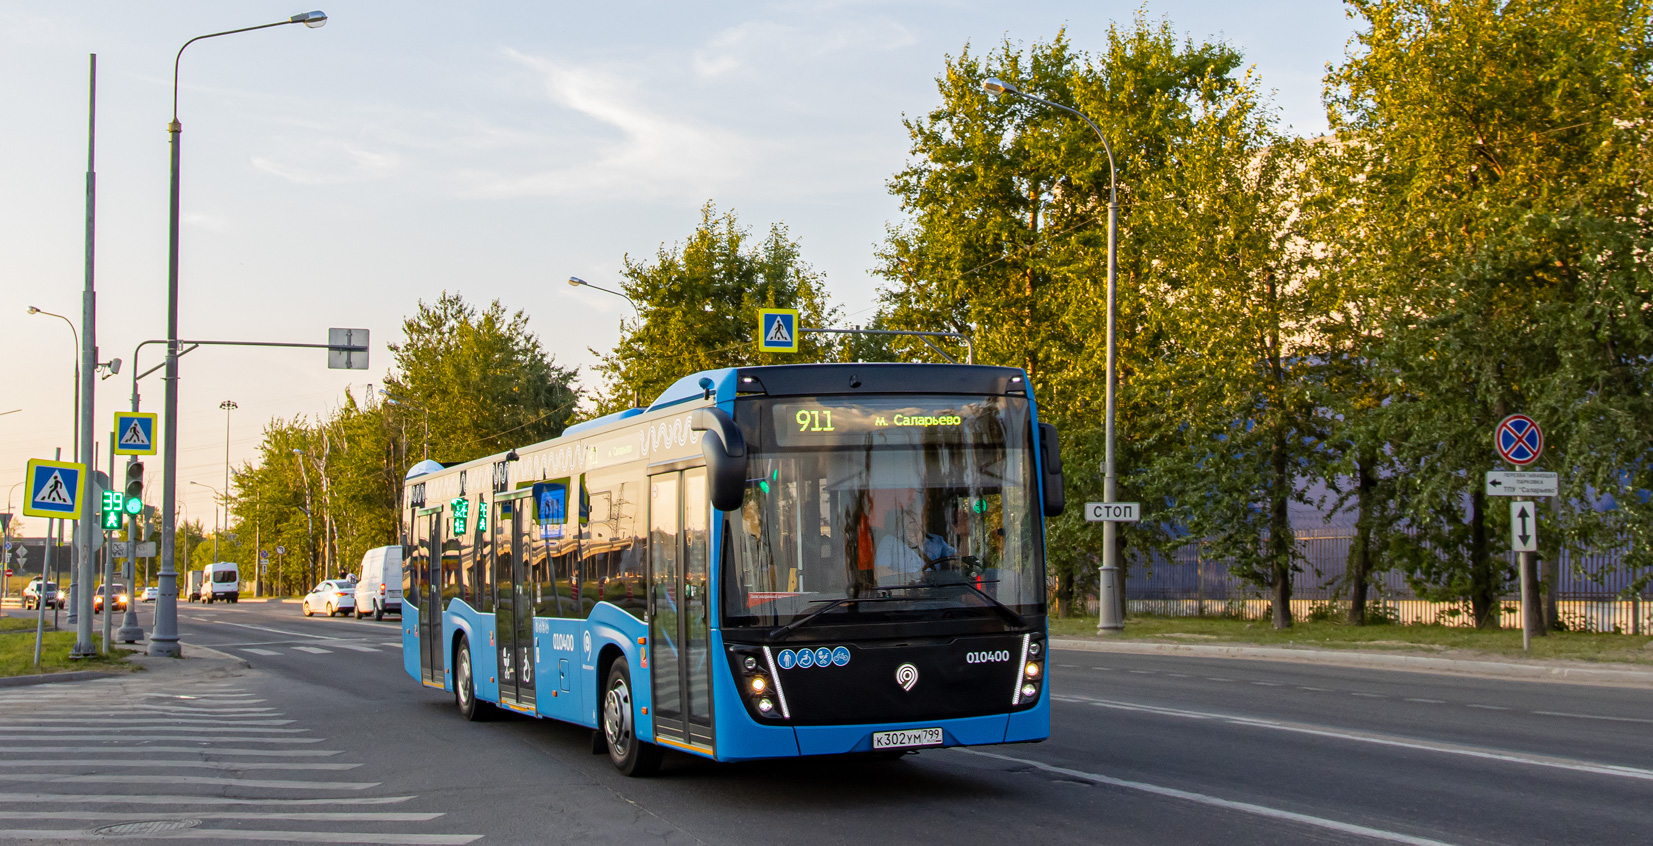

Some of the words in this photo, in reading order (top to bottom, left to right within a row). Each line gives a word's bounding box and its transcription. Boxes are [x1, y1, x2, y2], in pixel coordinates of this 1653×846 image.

[796, 410, 835, 432] 911
[875, 416, 889, 426] м.
[893, 414, 962, 428] Саларьево
[103, 491, 123, 511] 39
[1093, 505, 1132, 518] СТОП
[552, 633, 575, 652] 010400
[966, 650, 1010, 664] 010400
[922, 729, 940, 740] 799
